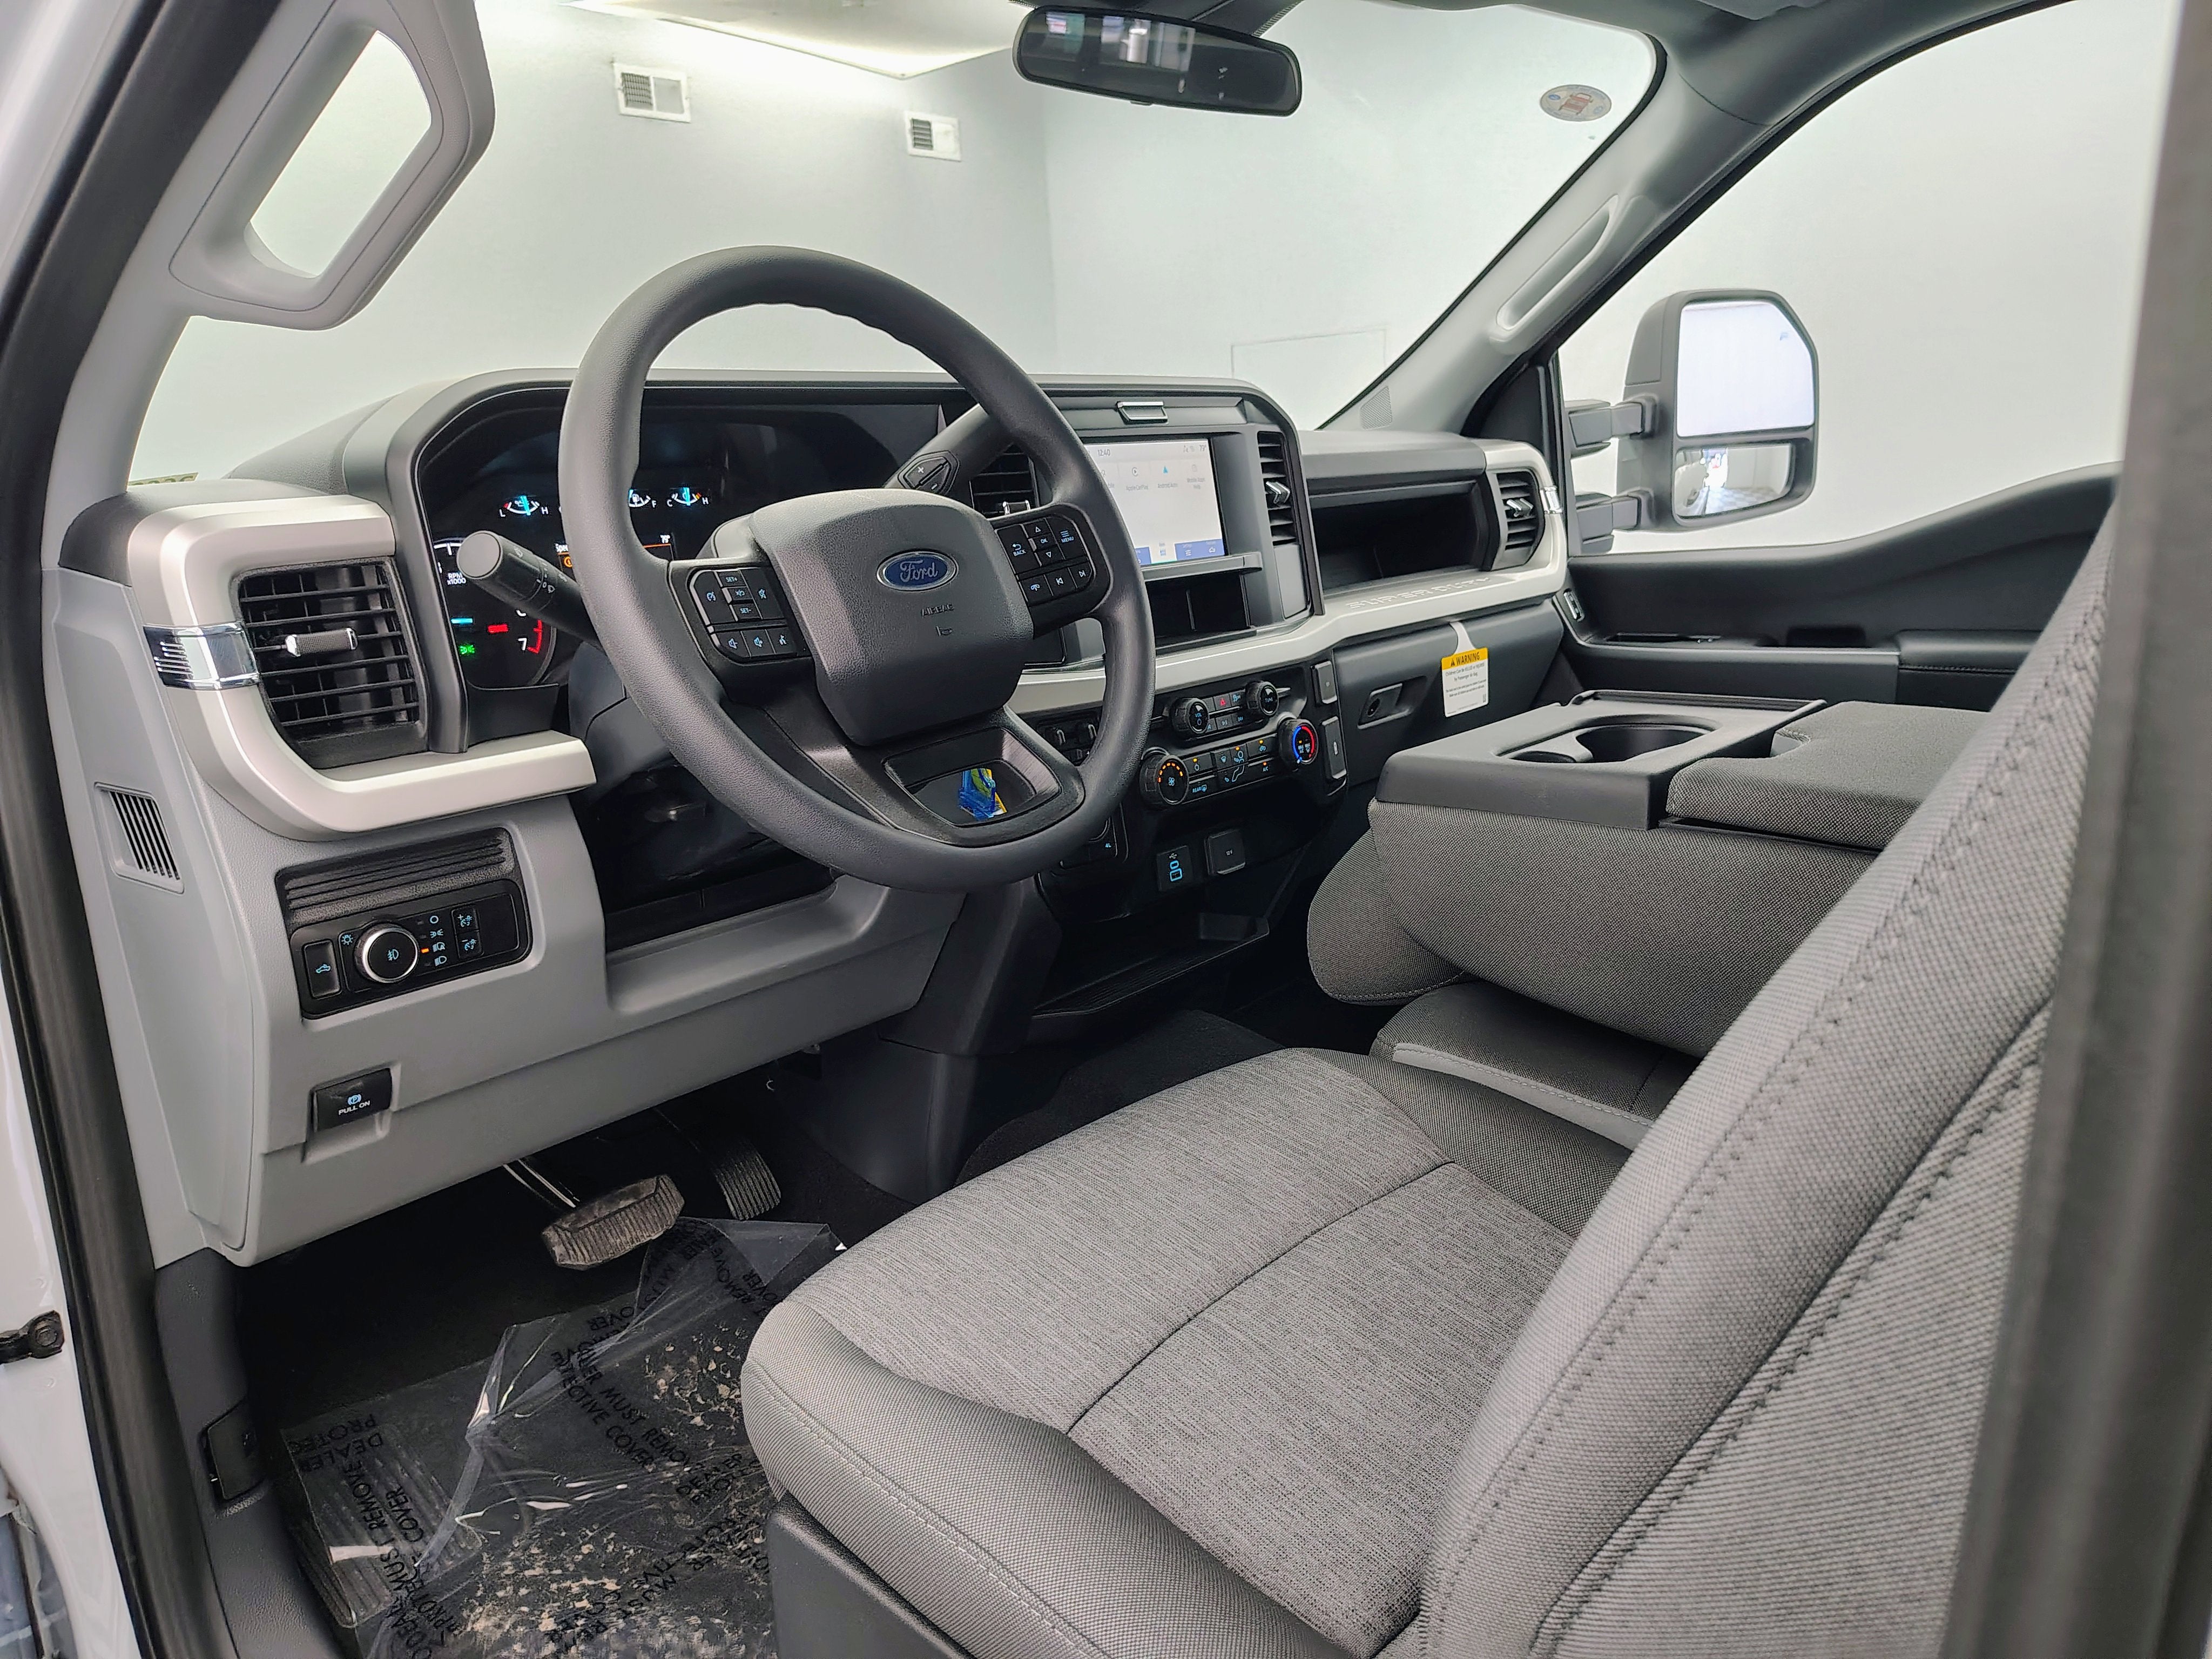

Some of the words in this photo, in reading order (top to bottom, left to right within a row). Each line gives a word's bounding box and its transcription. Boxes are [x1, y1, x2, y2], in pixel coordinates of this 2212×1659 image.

[899, 559, 939, 583] Ford
[1345, 589, 1431, 610] SUPER
[1431, 576, 1491, 592] DUTY
[921, 603, 955, 617] AIRBAG
[517, 638, 527, 651] 7
[1455, 651, 1480, 666] WARNING
[338, 1105, 358, 1116] PULL
[359, 1100, 370, 1108] ON
[600, 1383, 646, 1429] MUST
[604, 1422, 653, 1471] COVER
[350, 1461, 387, 1532] REMOVE
[386, 1486, 424, 1541] COVER
